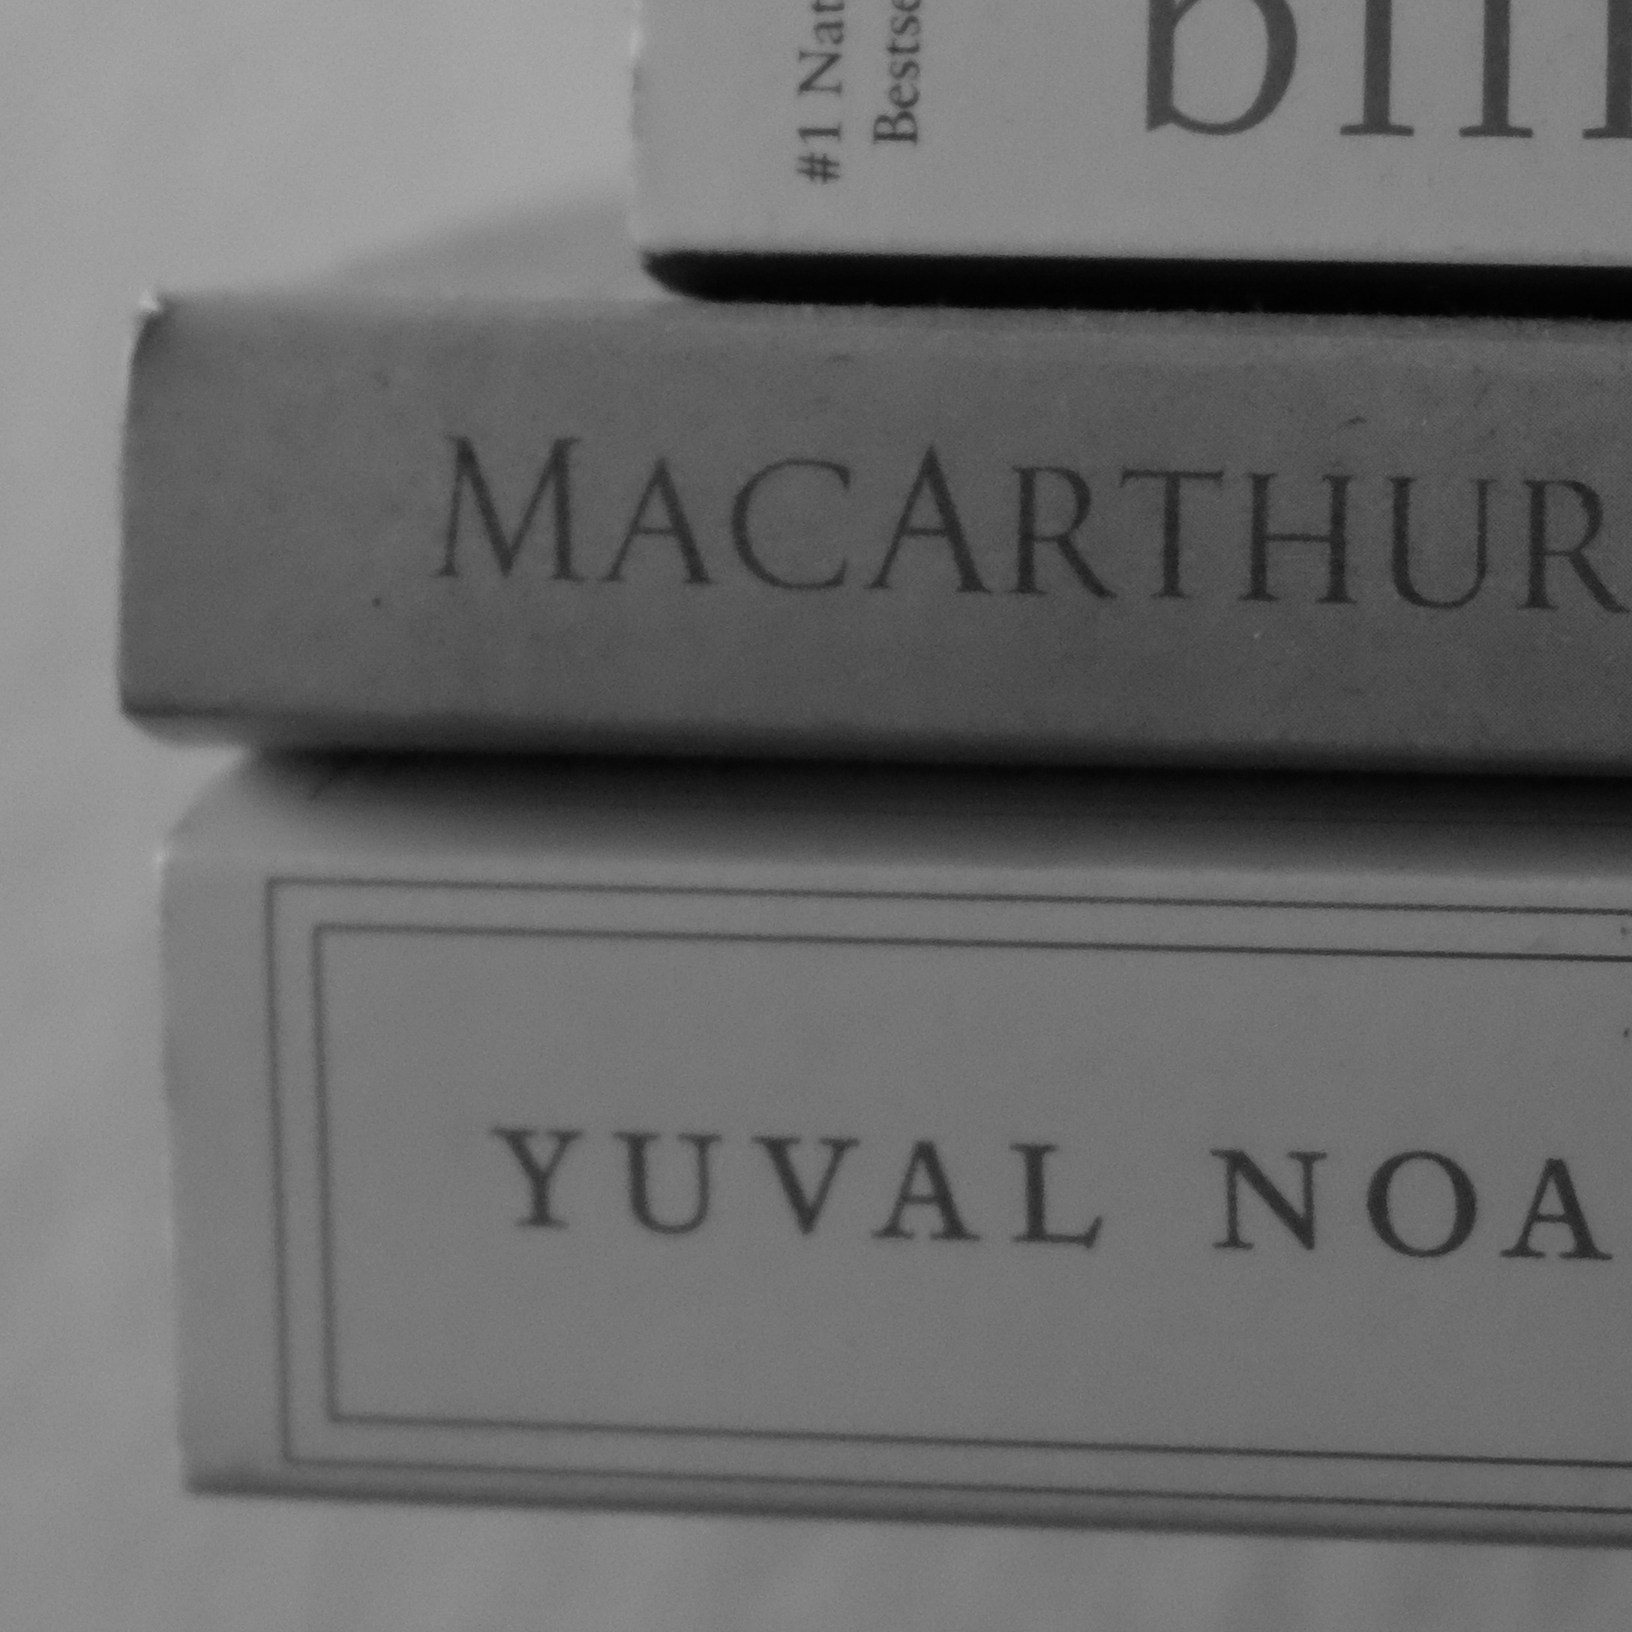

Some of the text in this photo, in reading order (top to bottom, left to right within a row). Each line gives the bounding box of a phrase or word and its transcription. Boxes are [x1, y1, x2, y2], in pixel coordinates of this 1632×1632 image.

[798, 122, 842, 185] #1
[489, 1125, 1613, 1261] YUVAL NOA
